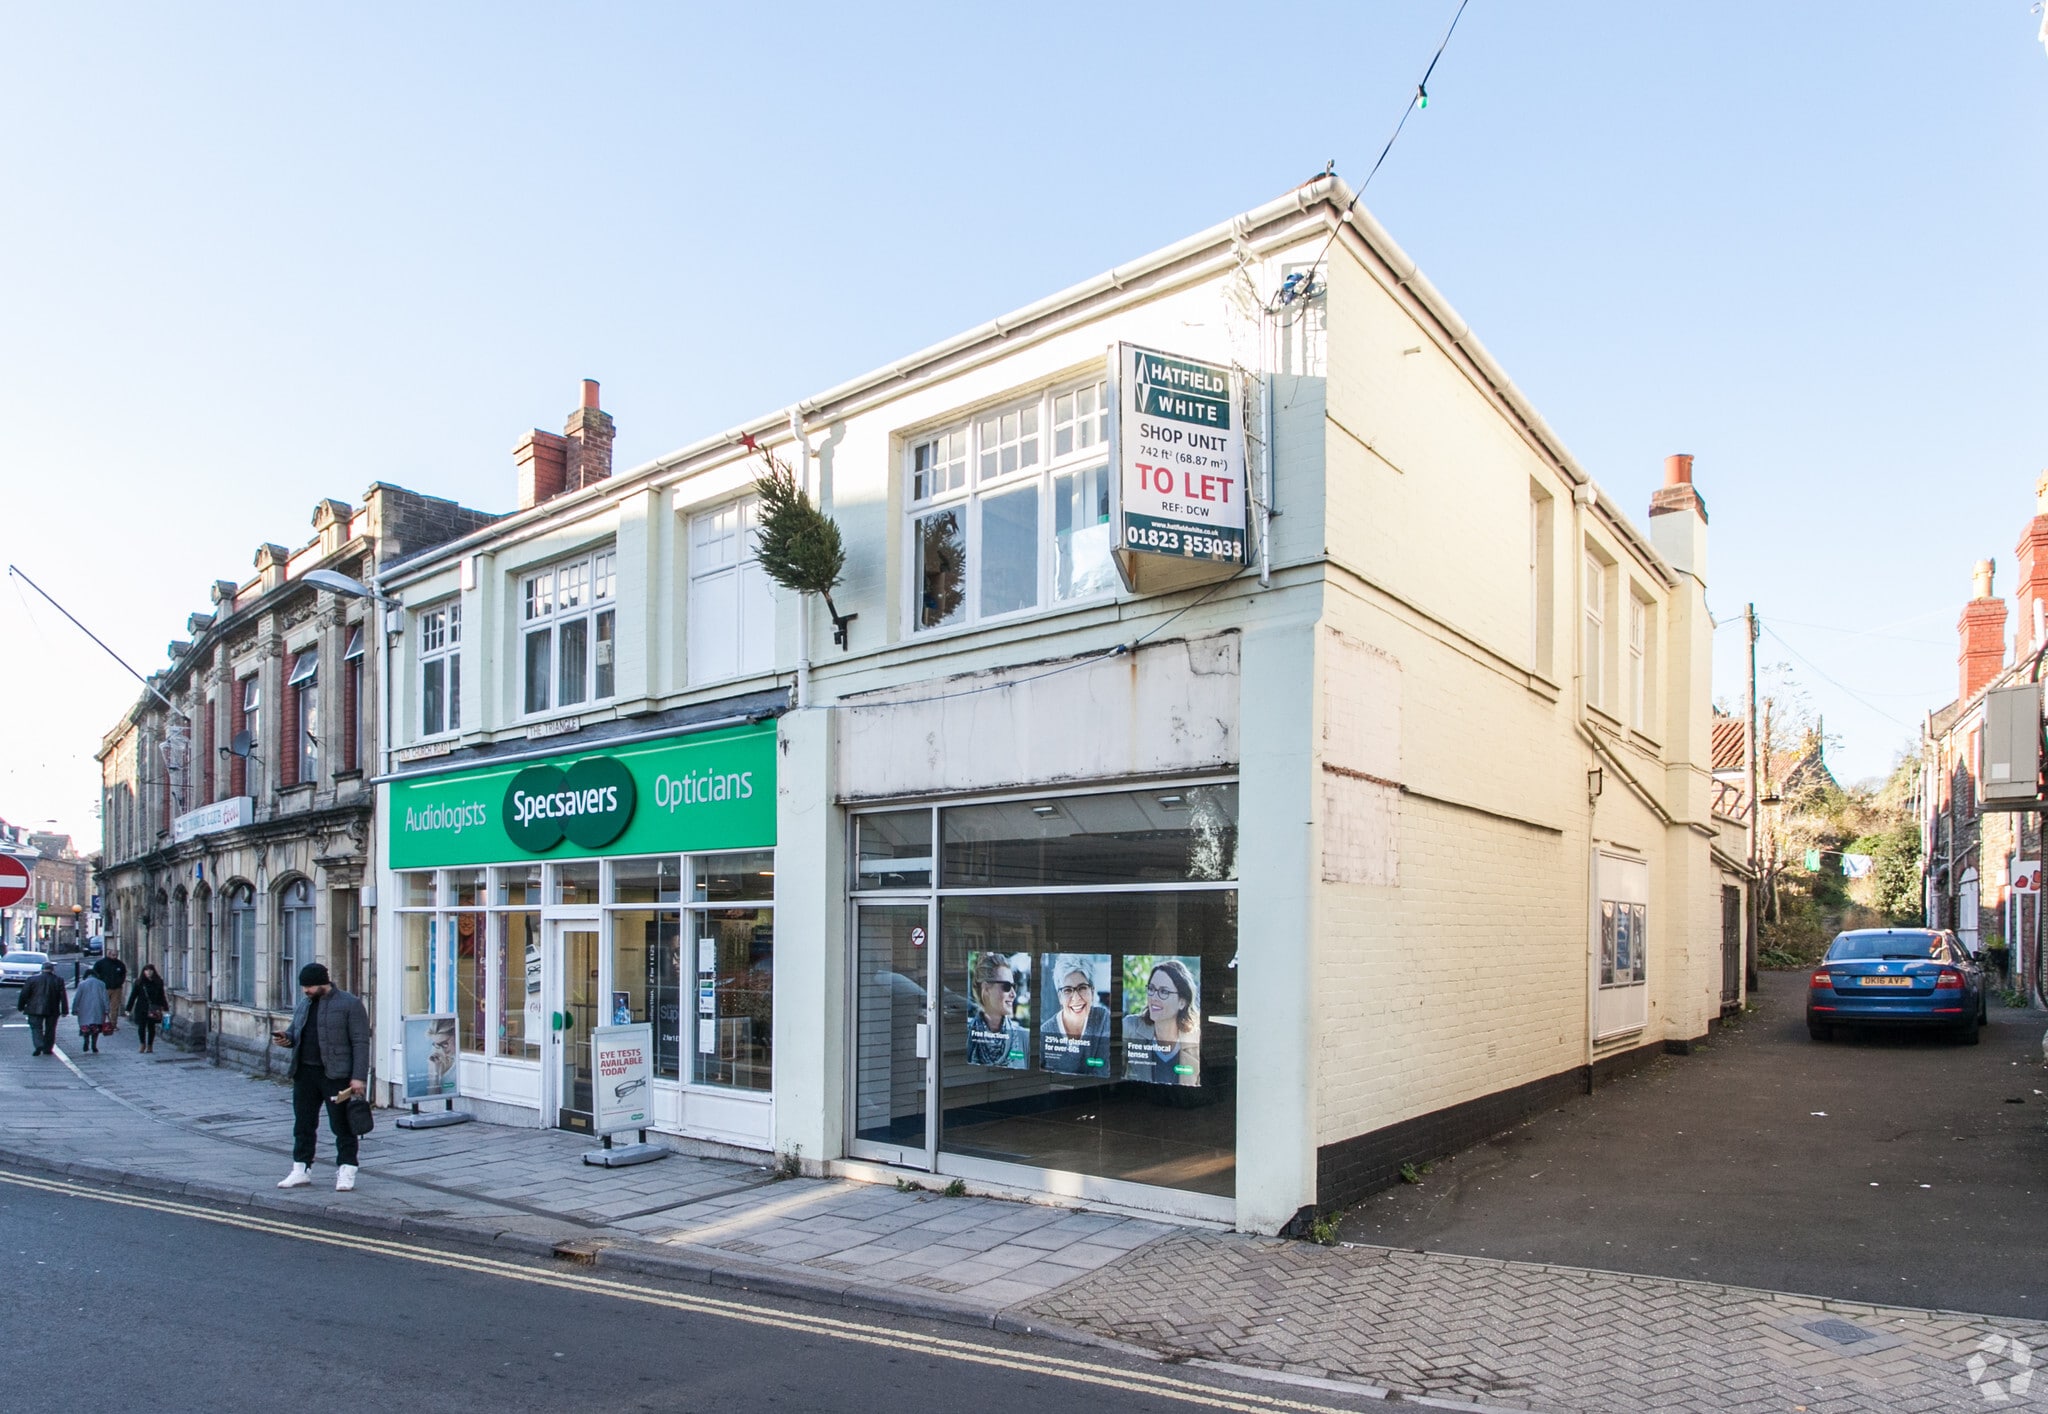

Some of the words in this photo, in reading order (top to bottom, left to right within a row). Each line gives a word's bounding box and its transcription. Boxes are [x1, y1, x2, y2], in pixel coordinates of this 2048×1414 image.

[1151, 363, 1224, 393] HATFIELD
[1158, 395, 1217, 421] WHITE
[1140, 422, 1183, 444] SHOP
[1188, 432, 1227, 452] UNIT
[1140, 445, 1159, 458] 742
[1175, 452, 1208, 466] (68.87
[1135, 463, 1174, 495] TO
[1184, 472, 1234, 503] LET
[1161, 501, 1184, 513] REF:
[1186, 505, 1210, 517] DCW
[1127, 526, 1179, 549] 01823
[1183, 534, 1242, 558] 353033
[530, 726, 542, 738] THE
[544, 717, 577, 735] TRIANGLE
[654, 768, 753, 814] Opticians
[513, 785, 618, 827] Specsavers
[405, 799, 487, 835] Audiologists
[1864, 977, 1886, 985] DK16
[1888, 977, 1906, 985] AVF
[971, 1030, 983, 1038] Free
[1044, 1035, 1059, 1044] 25%
[1059, 1036, 1069, 1044] off
[1068, 1038, 1091, 1047] glasses
[600, 1050, 616, 1060] EYE
[617, 1048, 641, 1058] TESTS
[1044, 1043, 1054, 1051] for
[1127, 1042, 1143, 1050] Free
[1143, 1043, 1172, 1052] varifocal
[1127, 1050, 1149, 1059] lenses
[600, 1057, 643, 1068] AVAILABLE
[600, 1067, 627, 1077] TODAY
